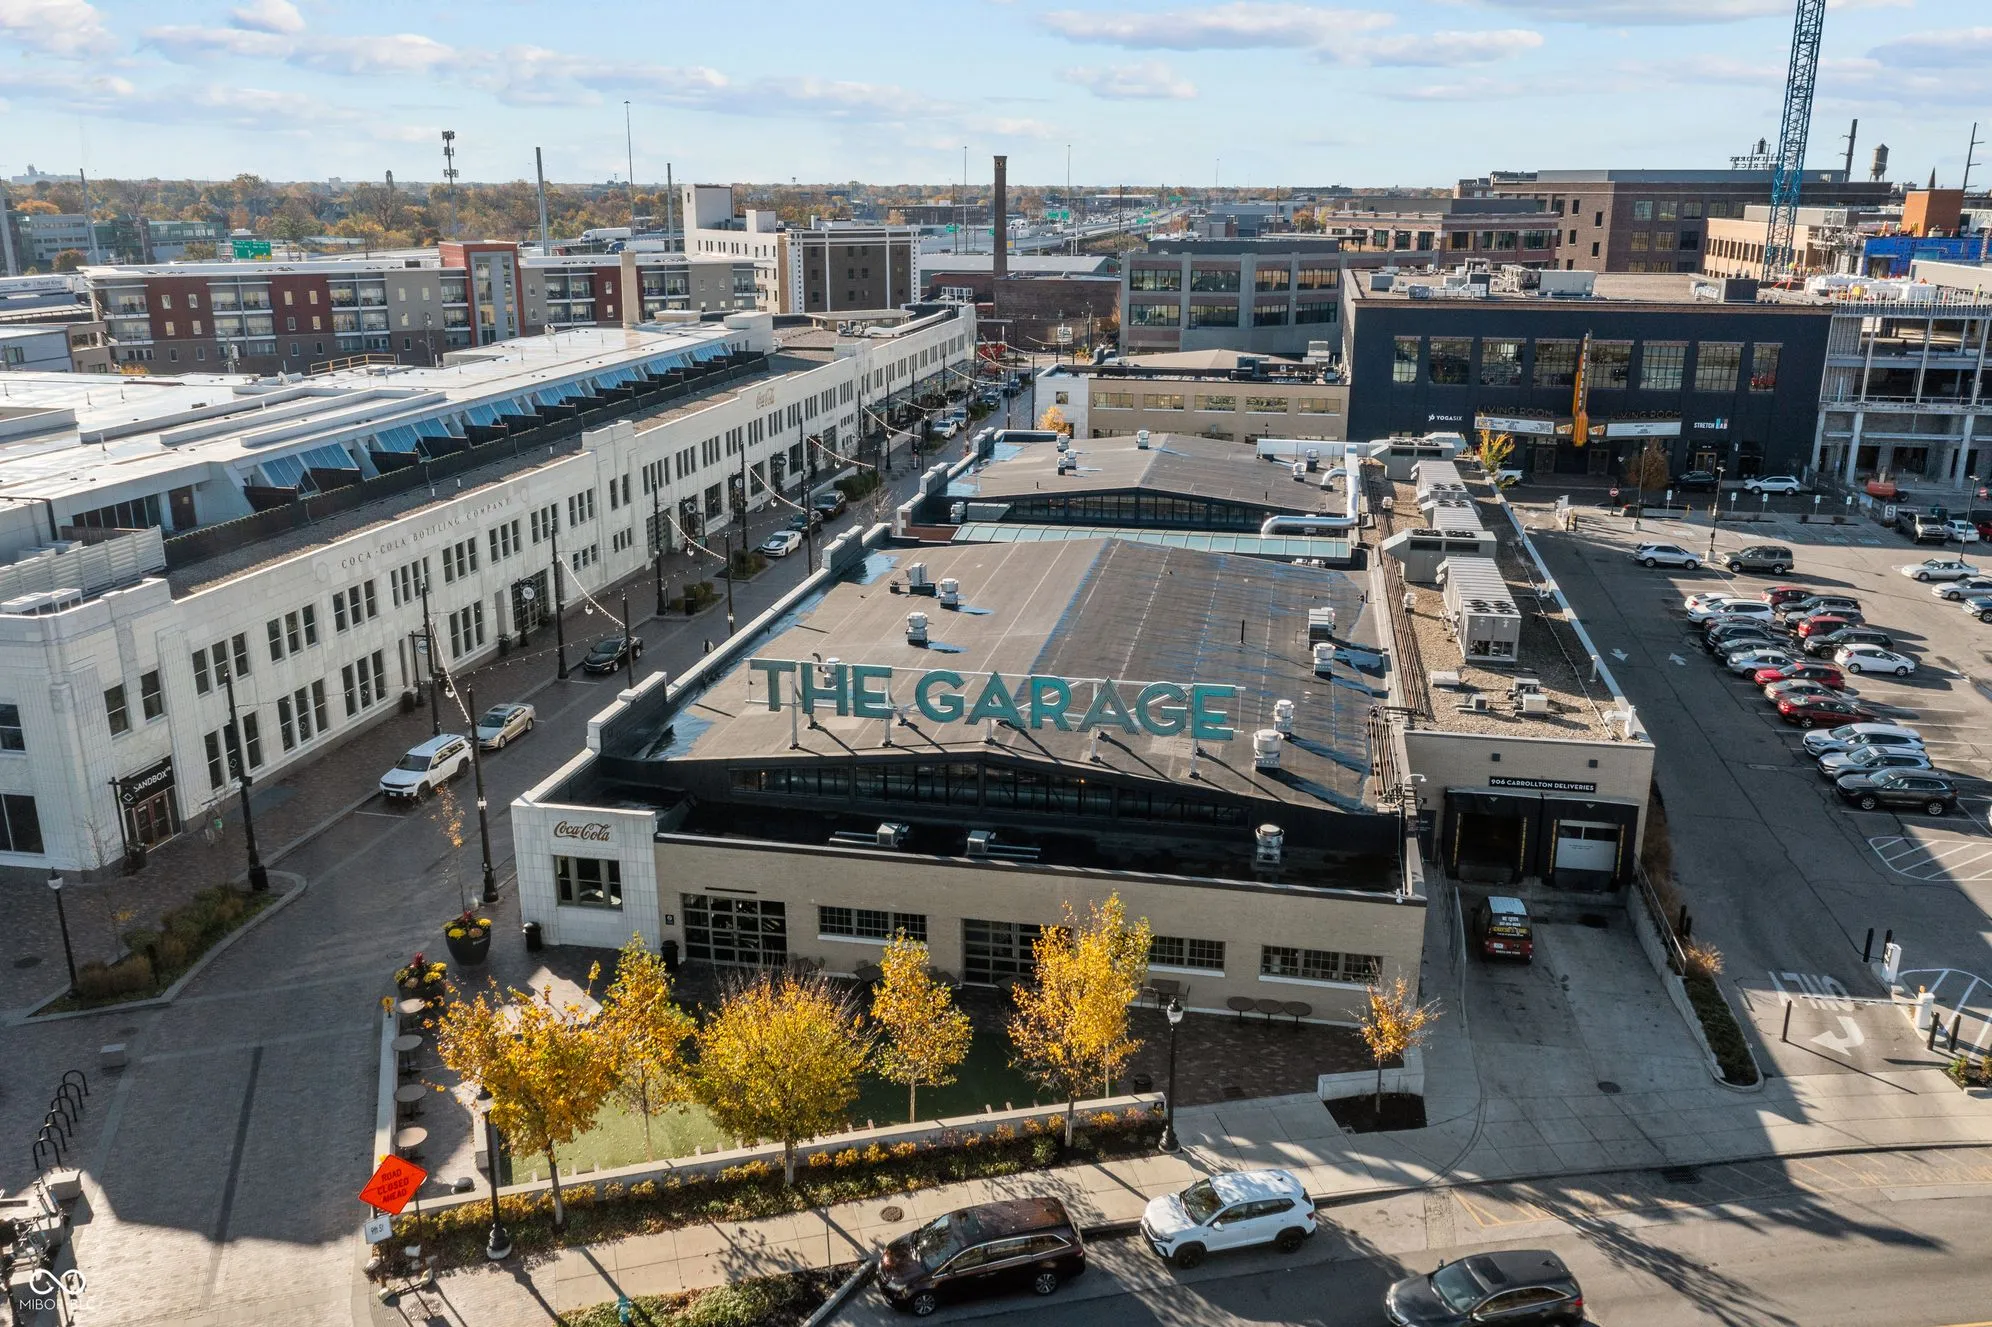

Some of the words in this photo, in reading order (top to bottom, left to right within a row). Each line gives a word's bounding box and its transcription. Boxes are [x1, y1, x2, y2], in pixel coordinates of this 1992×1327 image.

[1520, 407, 1554, 417] ROOM
[413, 518, 460, 542] BOTTLING
[466, 497, 512, 520] COMPANY
[750, 658, 892, 720] THE
[914, 669, 1235, 741] GARAGE
[1506, 780, 1553, 788] CARROLLTON
[1554, 783, 1594, 791] DELIVERIES
[381, 1168, 402, 1182] ROAD
[377, 1177, 409, 1196] CLOSED
[382, 1188, 407, 1203] AHEAD
